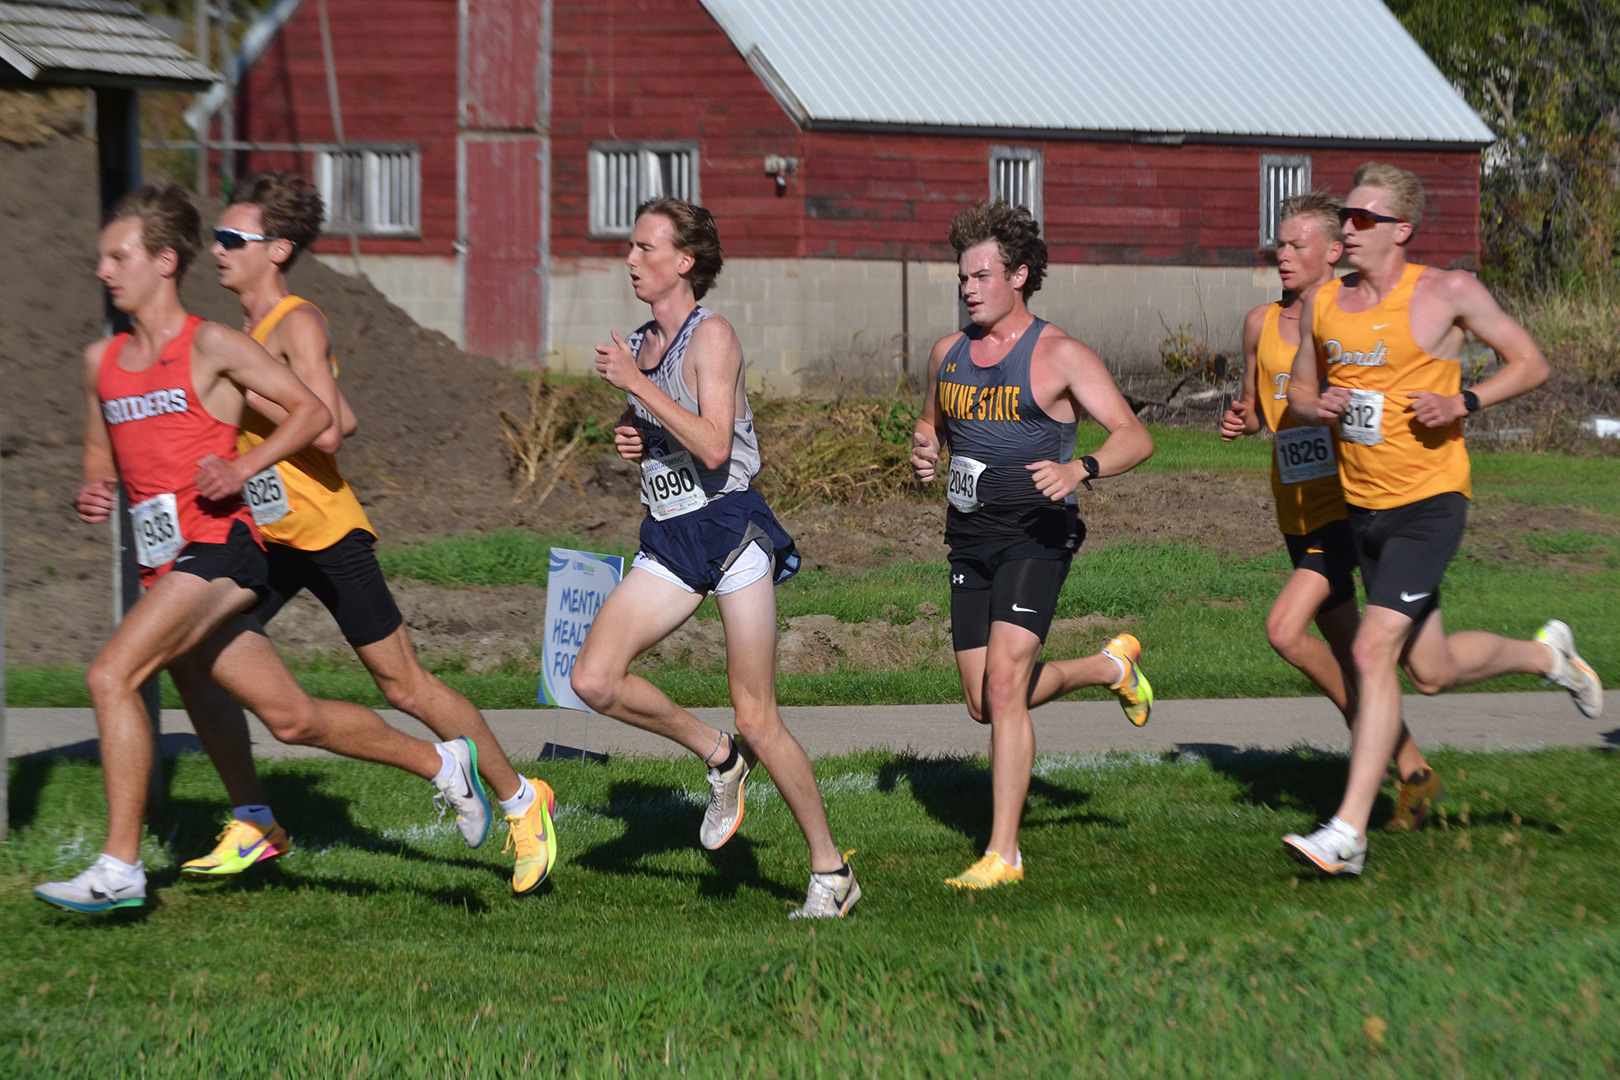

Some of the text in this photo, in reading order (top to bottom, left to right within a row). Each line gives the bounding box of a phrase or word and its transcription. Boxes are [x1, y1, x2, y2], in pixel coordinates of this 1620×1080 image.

[1324, 339, 1388, 367] Dordt
[977, 385, 1021, 421] STATE
[1280, 437, 1329, 467] 1826
[649, 467, 696, 502] 1990
[949, 469, 974, 498] 2043
[552, 618, 591, 647] HEALT
